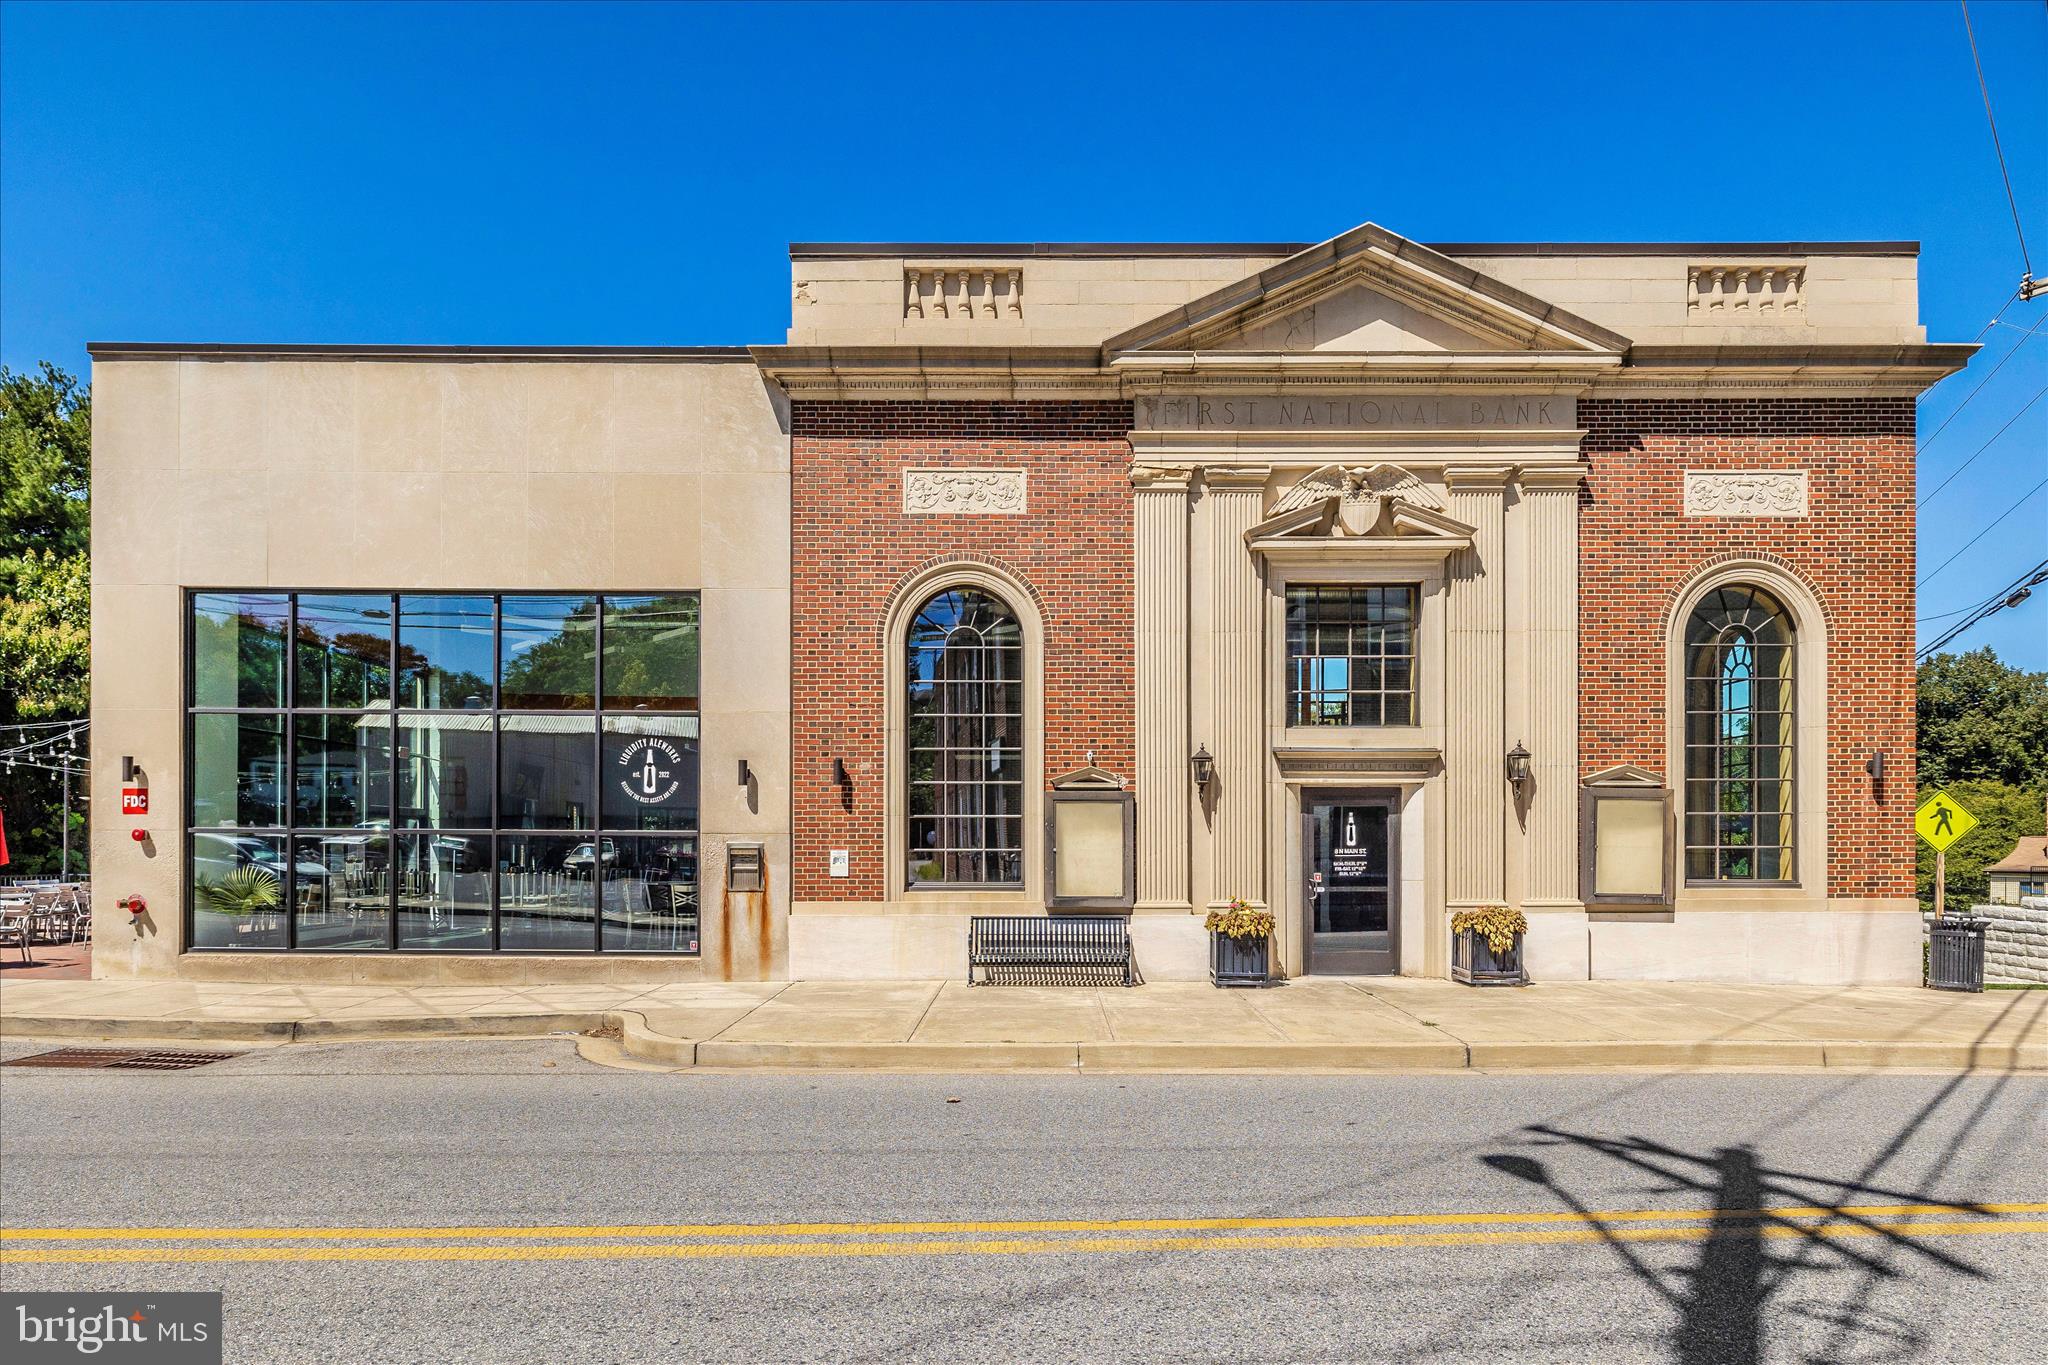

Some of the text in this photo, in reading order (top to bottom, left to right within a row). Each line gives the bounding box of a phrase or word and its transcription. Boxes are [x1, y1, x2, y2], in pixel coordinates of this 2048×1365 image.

[1163, 401, 1554, 425] FIRST NATIONAL BANK
[619, 738, 680, 765] LIQUIDITY ALEWORKS
[124, 795, 146, 808] FDC
